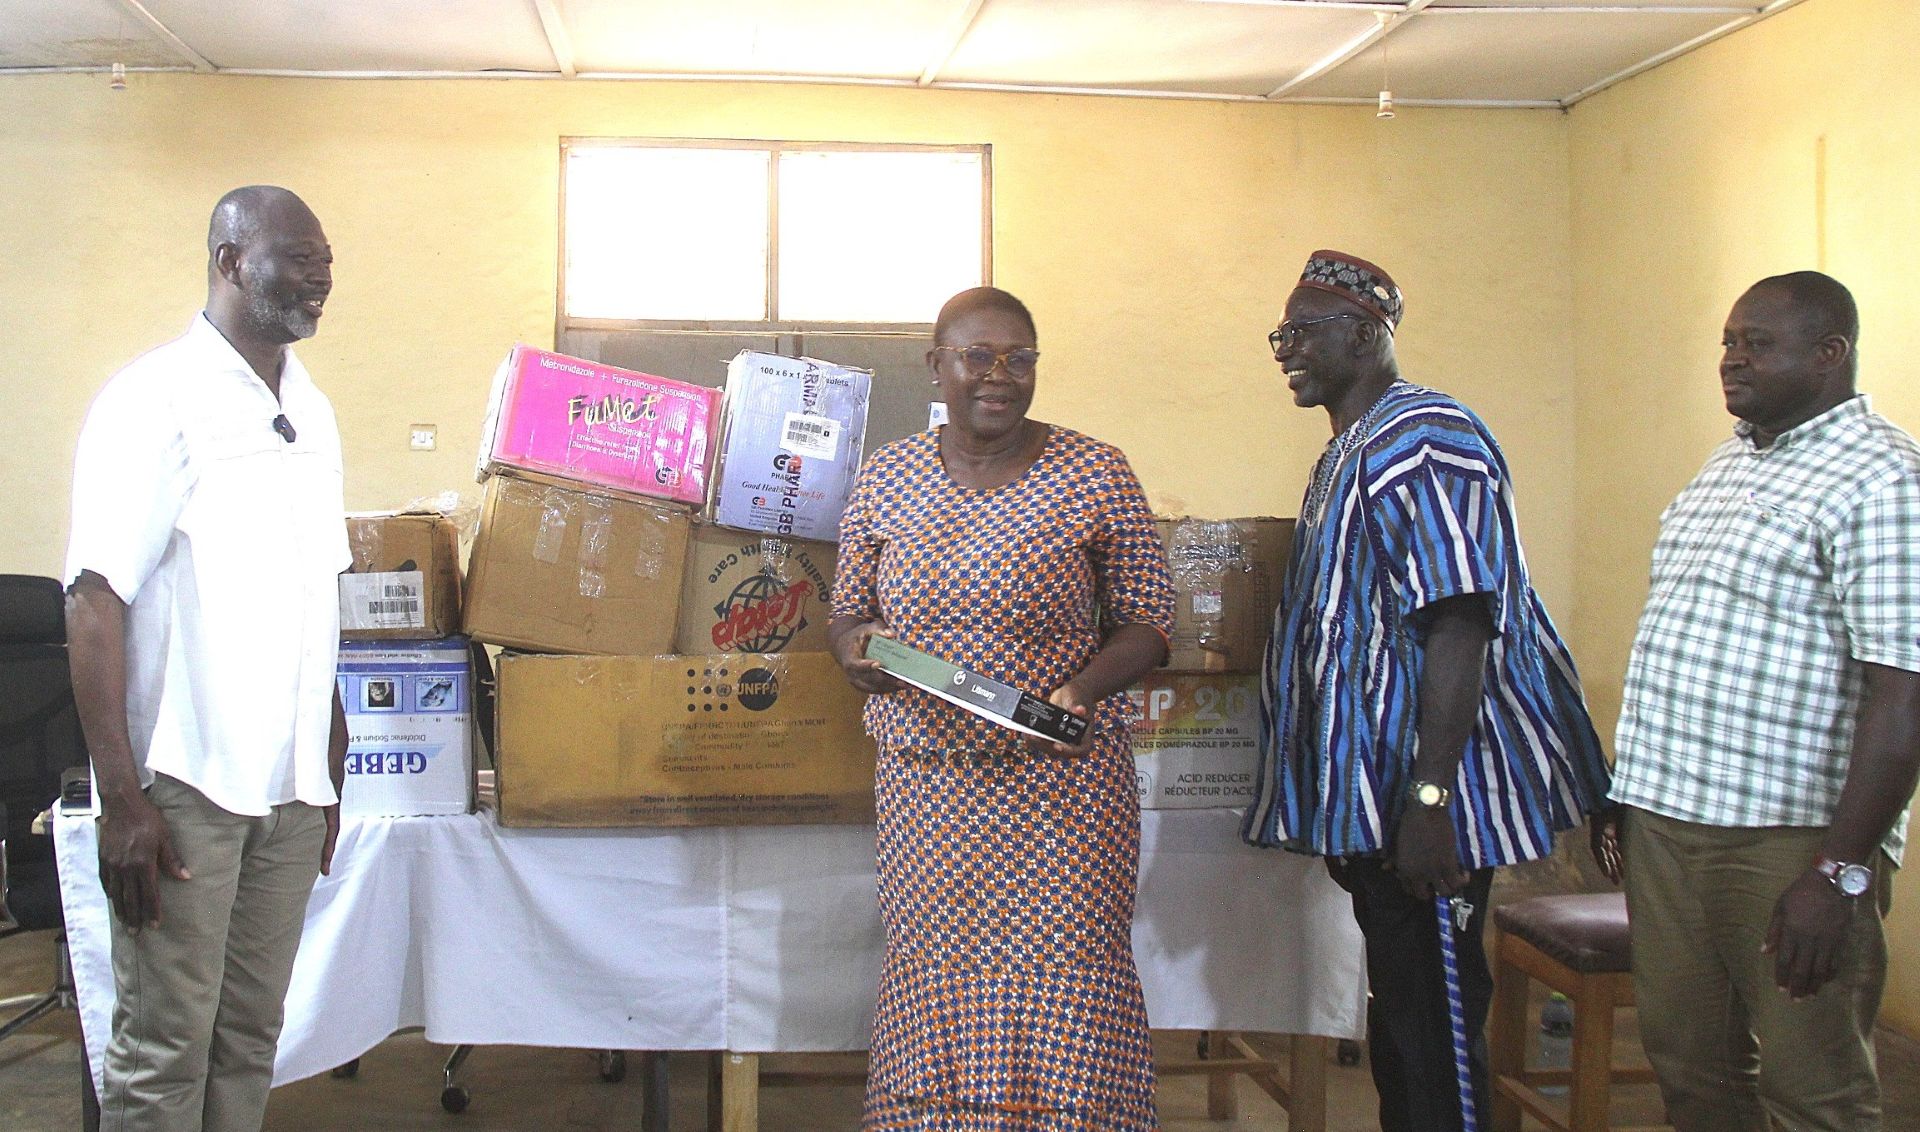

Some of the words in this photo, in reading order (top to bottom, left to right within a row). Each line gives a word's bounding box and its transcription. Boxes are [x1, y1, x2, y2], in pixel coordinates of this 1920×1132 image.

[540, 358, 595, 377] Metronidazole
[760, 366, 774, 375] 100
[782, 369, 788, 377] 6
[567, 393, 658, 425] FuMet
[741, 480, 761, 490] Good
[708, 553, 738, 584] Care
[736, 683, 779, 696] UNFPA
[1194, 686, 1249, 720] 20
[1158, 727, 1200, 735] CAPSULES
[1225, 727, 1239, 735] MG
[391, 734, 426, 742] Diclofenac
[345, 751, 427, 775] GEBE
[1177, 773, 1202, 783] ACID
[1204, 773, 1250, 783] REDUCER
[1164, 784, 1219, 796] RÉDUCTEUR
